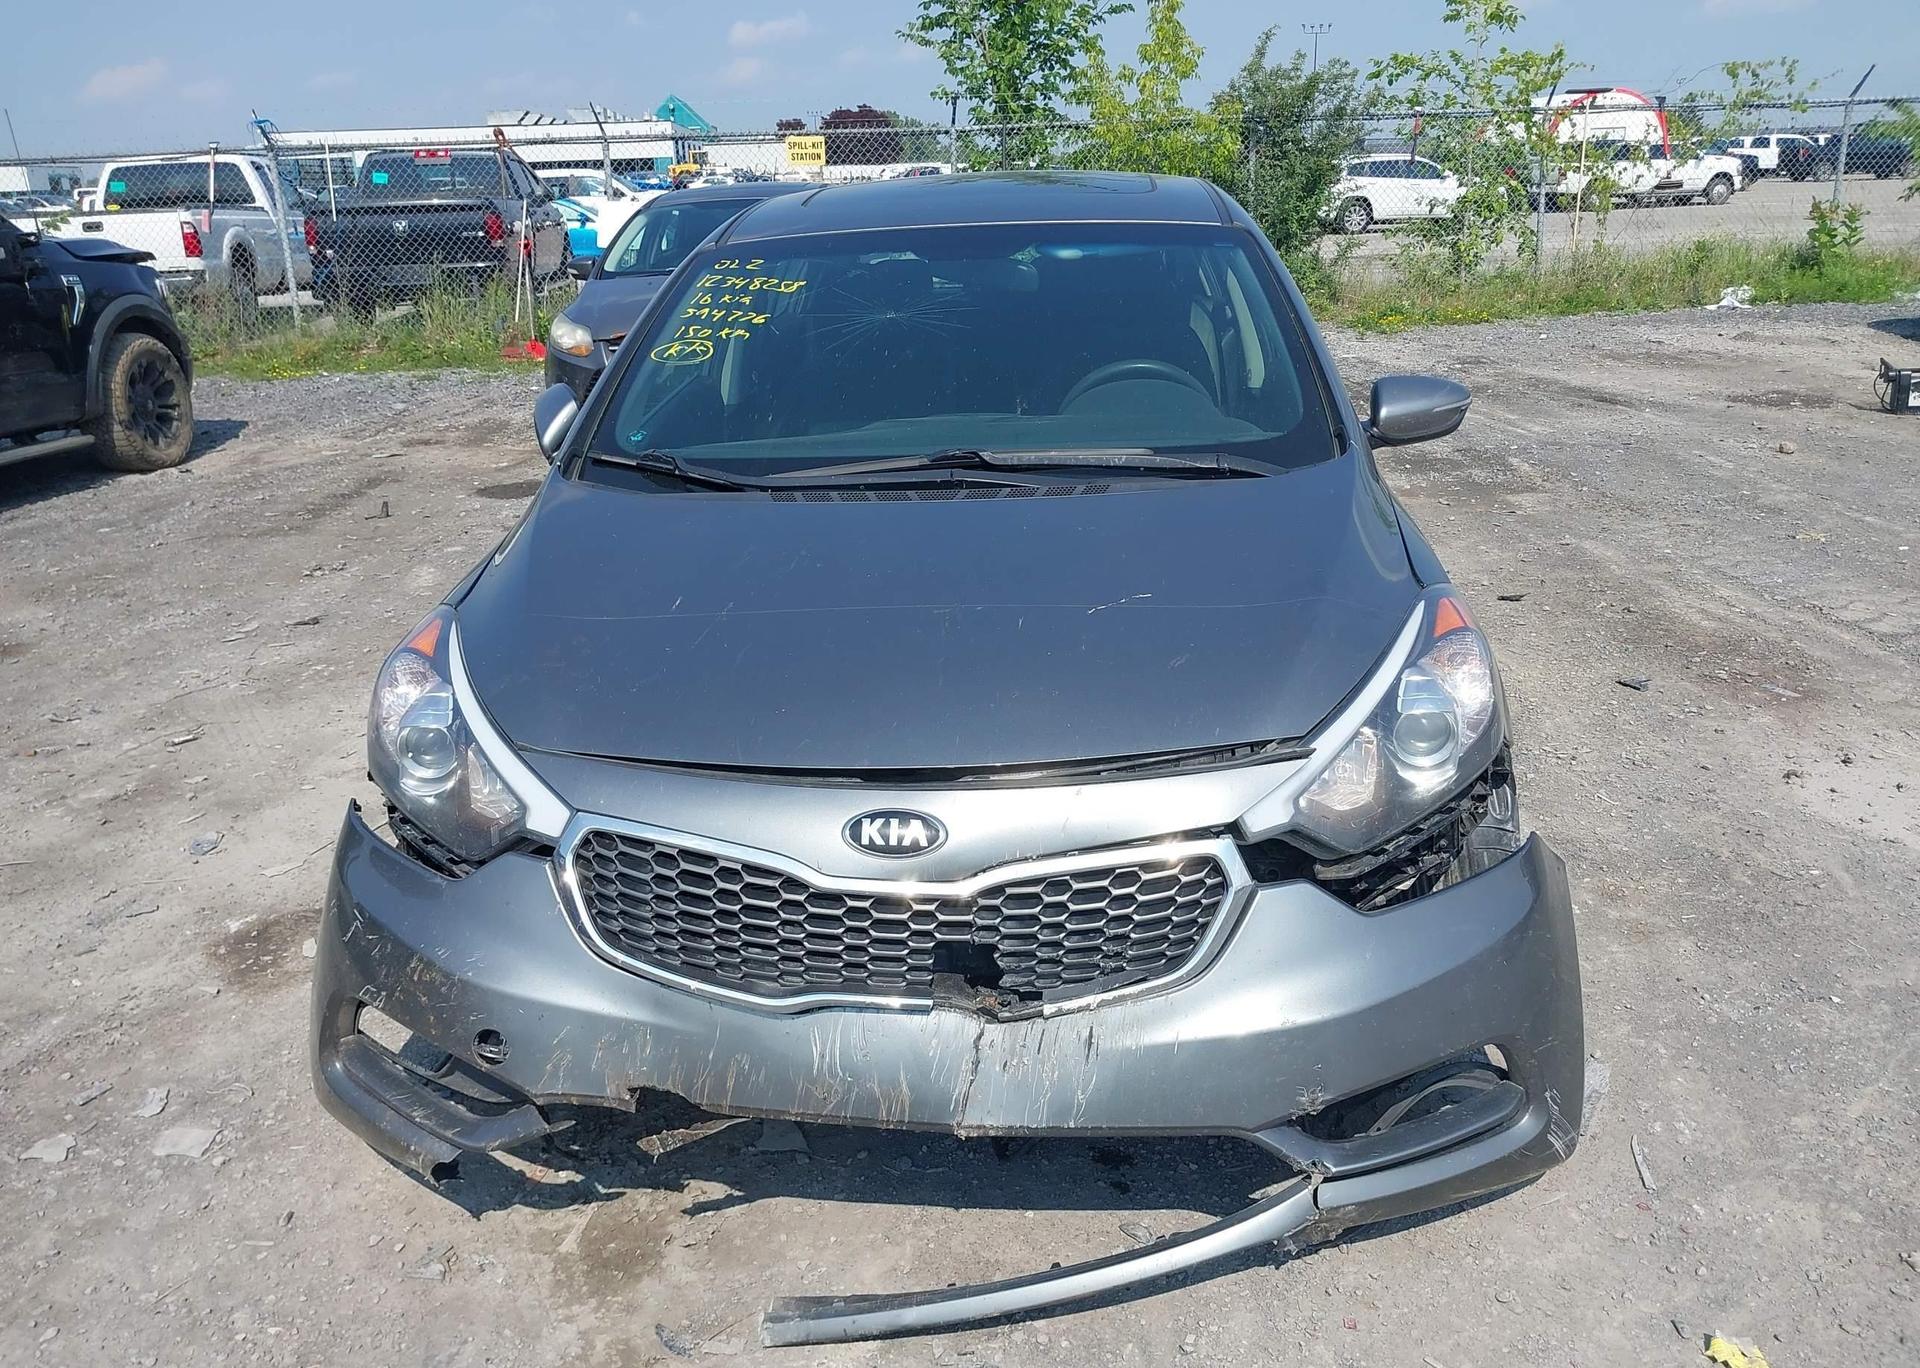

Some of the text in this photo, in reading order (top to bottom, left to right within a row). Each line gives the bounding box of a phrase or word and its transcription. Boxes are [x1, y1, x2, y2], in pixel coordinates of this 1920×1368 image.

[787, 141, 823, 150] SPILL-KIT
[791, 152, 822, 161] STATION
[674, 326, 713, 339] 150
[860, 817, 929, 847] KIA
